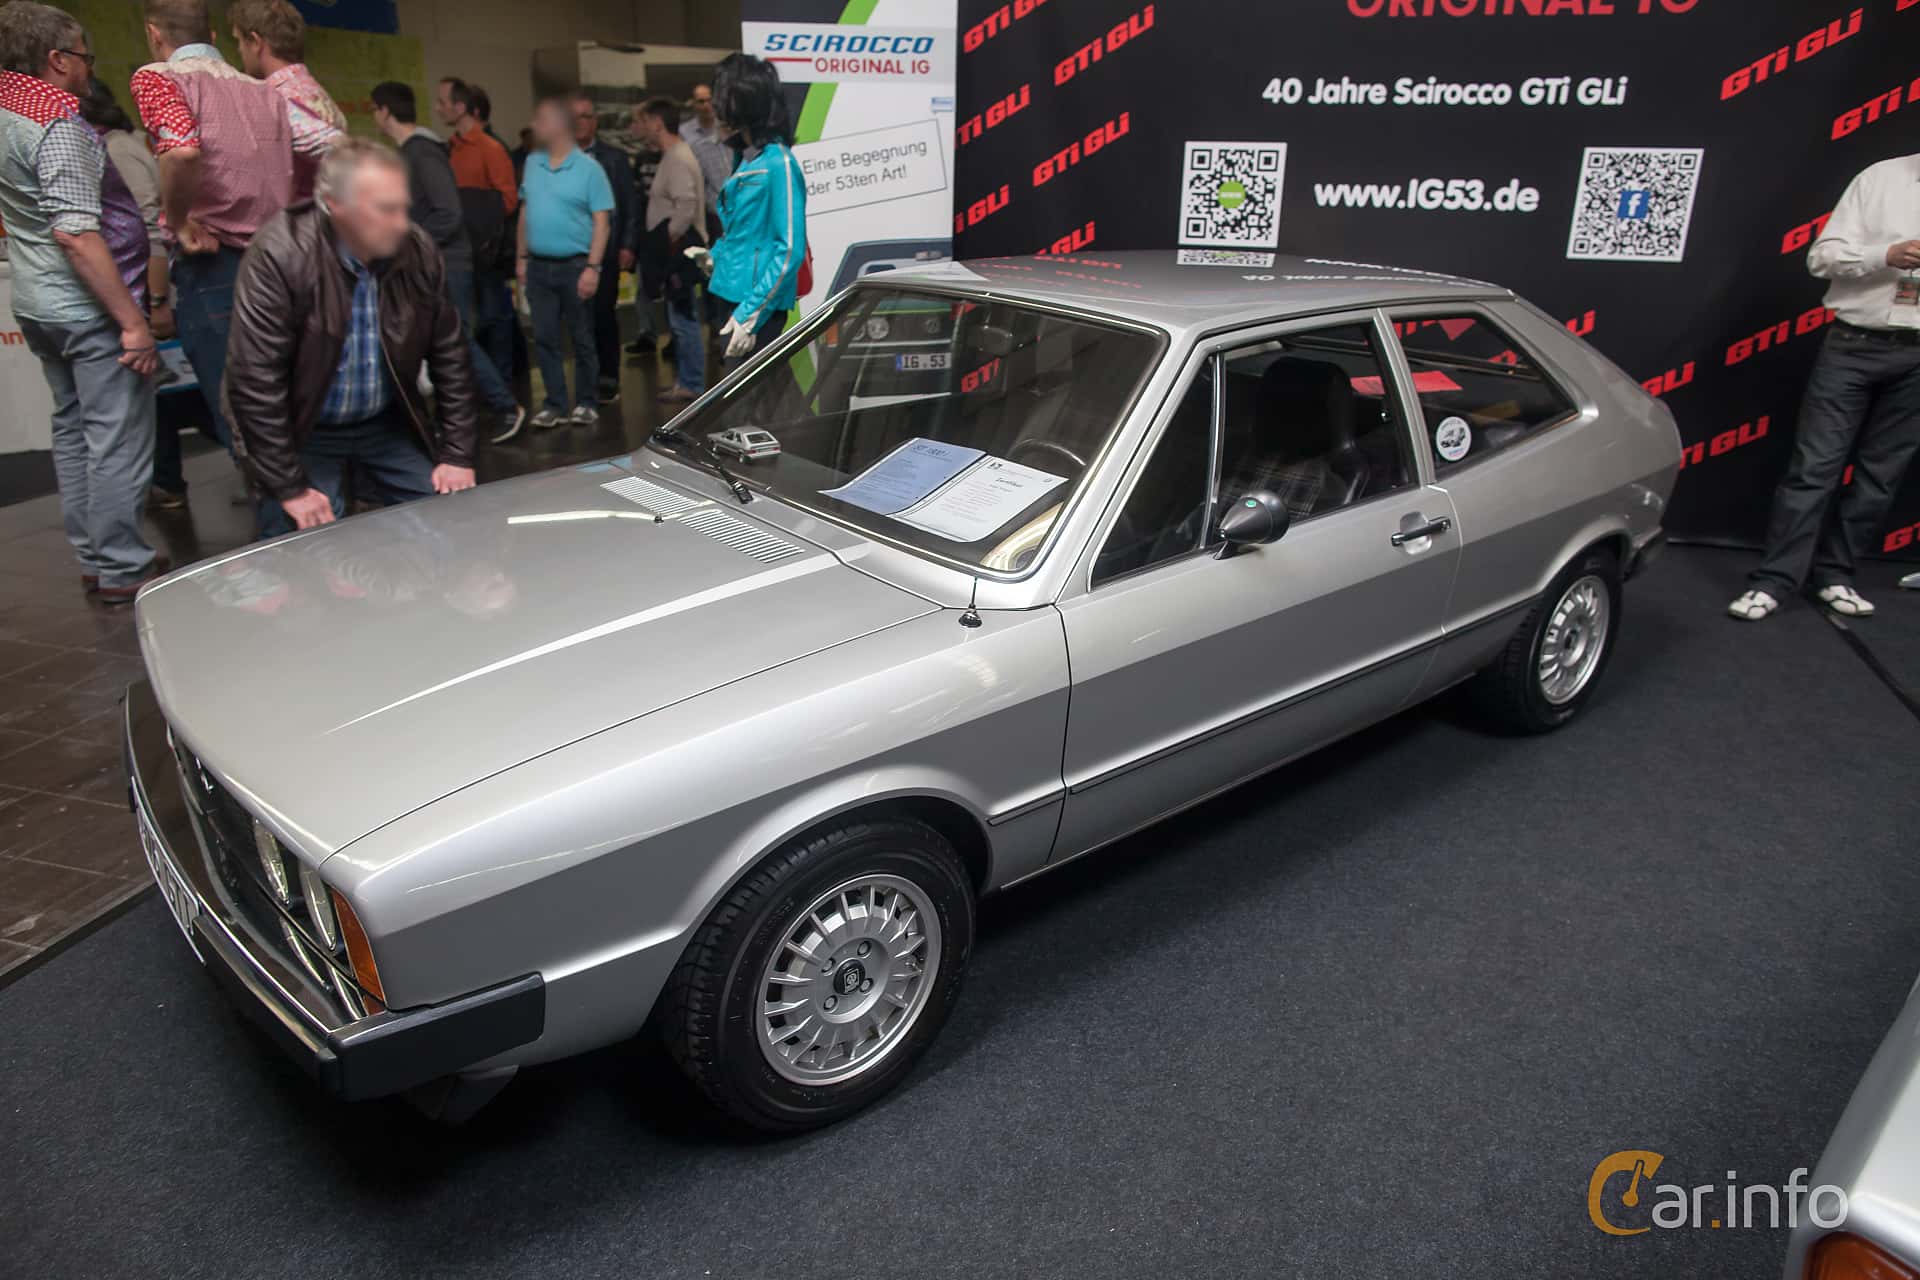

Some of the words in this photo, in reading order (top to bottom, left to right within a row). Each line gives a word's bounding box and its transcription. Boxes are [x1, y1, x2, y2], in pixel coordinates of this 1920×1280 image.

[764, 34, 934, 54] SCIROCCO
[815, 58, 905, 74] ORIGINAL
[911, 60, 930, 75] IG
[1262, 77, 1303, 104] 40
[1307, 76, 1387, 105] Jahre
[1392, 76, 1512, 105] Scirocco
[1519, 76, 1571, 105] GTi
[1577, 76, 1629, 105] GLi
[802, 160, 836, 174] Eine
[840, 142, 927, 168] Begegnung
[806, 181, 830, 196] der
[835, 173, 878, 190] 53ten
[882, 164, 907, 180] Art!
[1314, 178, 1540, 212] www.IG53.de
